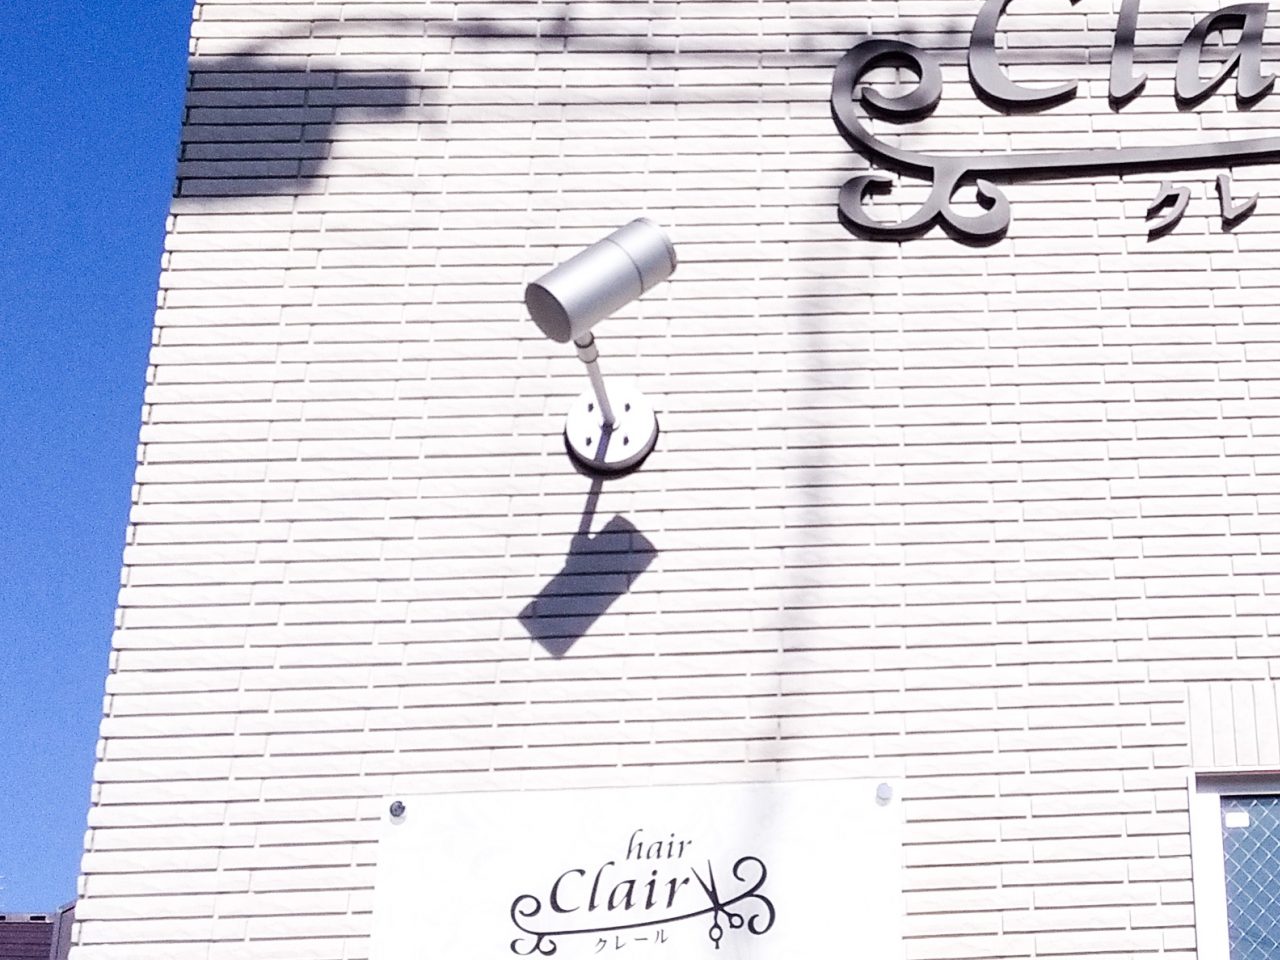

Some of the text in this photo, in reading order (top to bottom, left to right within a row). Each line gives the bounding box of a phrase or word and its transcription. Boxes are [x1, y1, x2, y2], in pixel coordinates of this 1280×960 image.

[626, 828, 693, 861] hair
[549, 861, 689, 913] Clair
[594, 929, 669, 953] クレール
